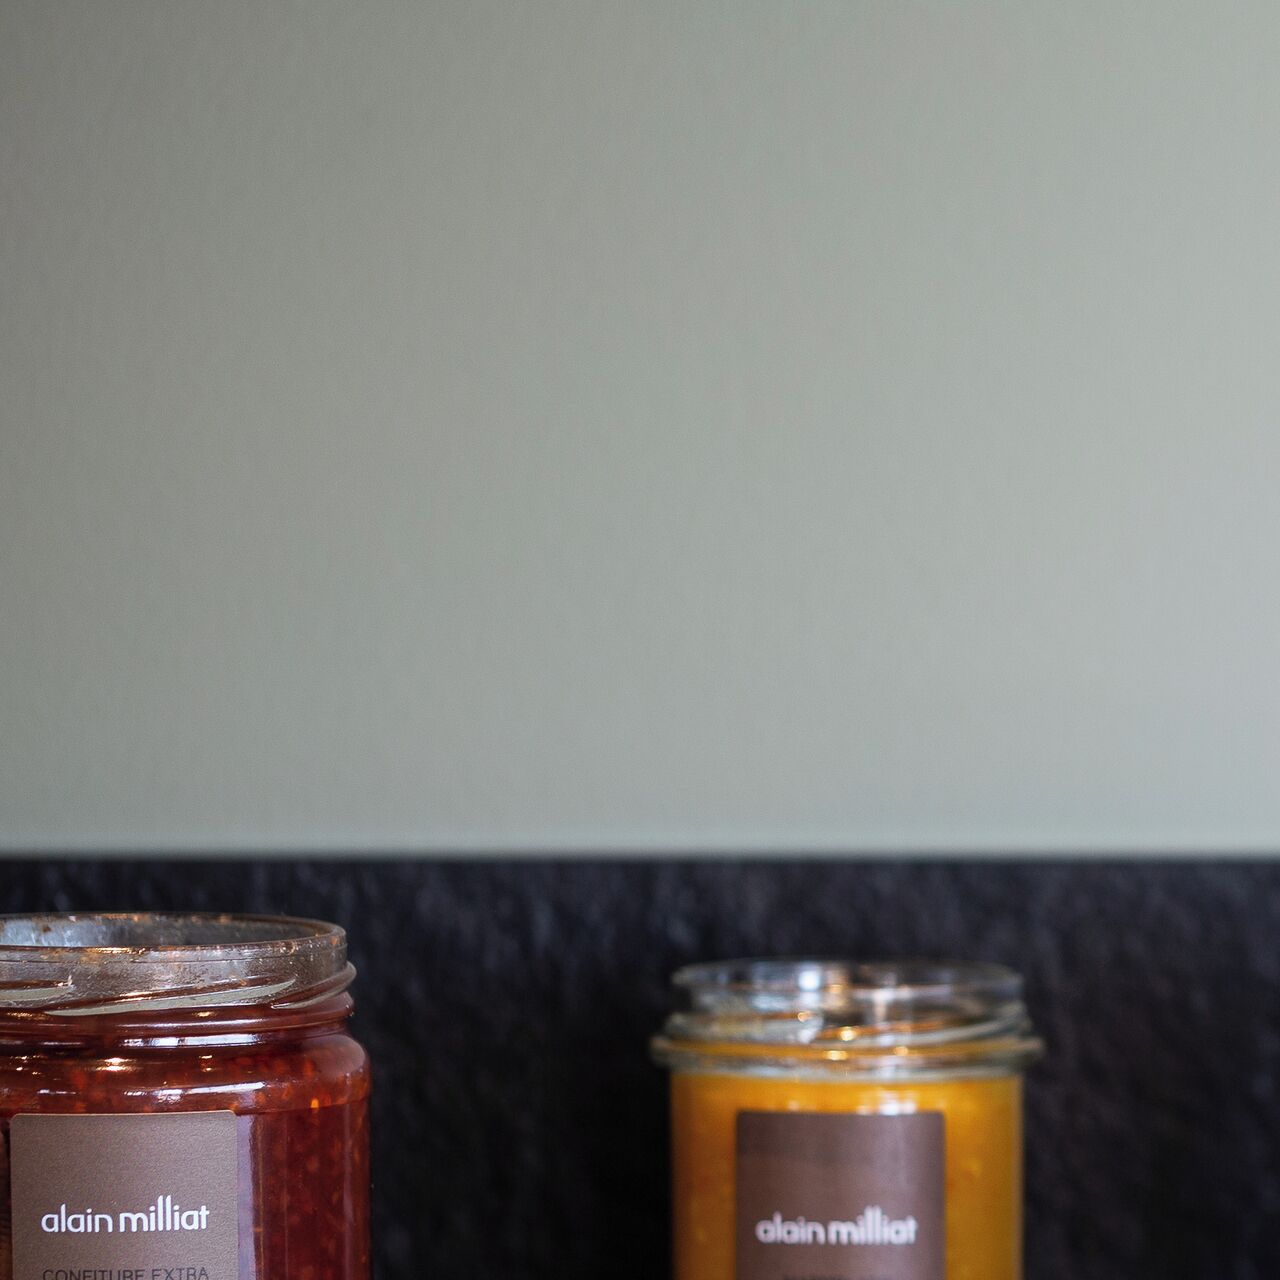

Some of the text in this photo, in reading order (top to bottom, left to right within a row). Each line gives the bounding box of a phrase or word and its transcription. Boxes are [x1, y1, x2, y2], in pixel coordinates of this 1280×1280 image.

[41, 1195, 210, 1233] alain milliat
[755, 1204, 918, 1245] alain milliat
